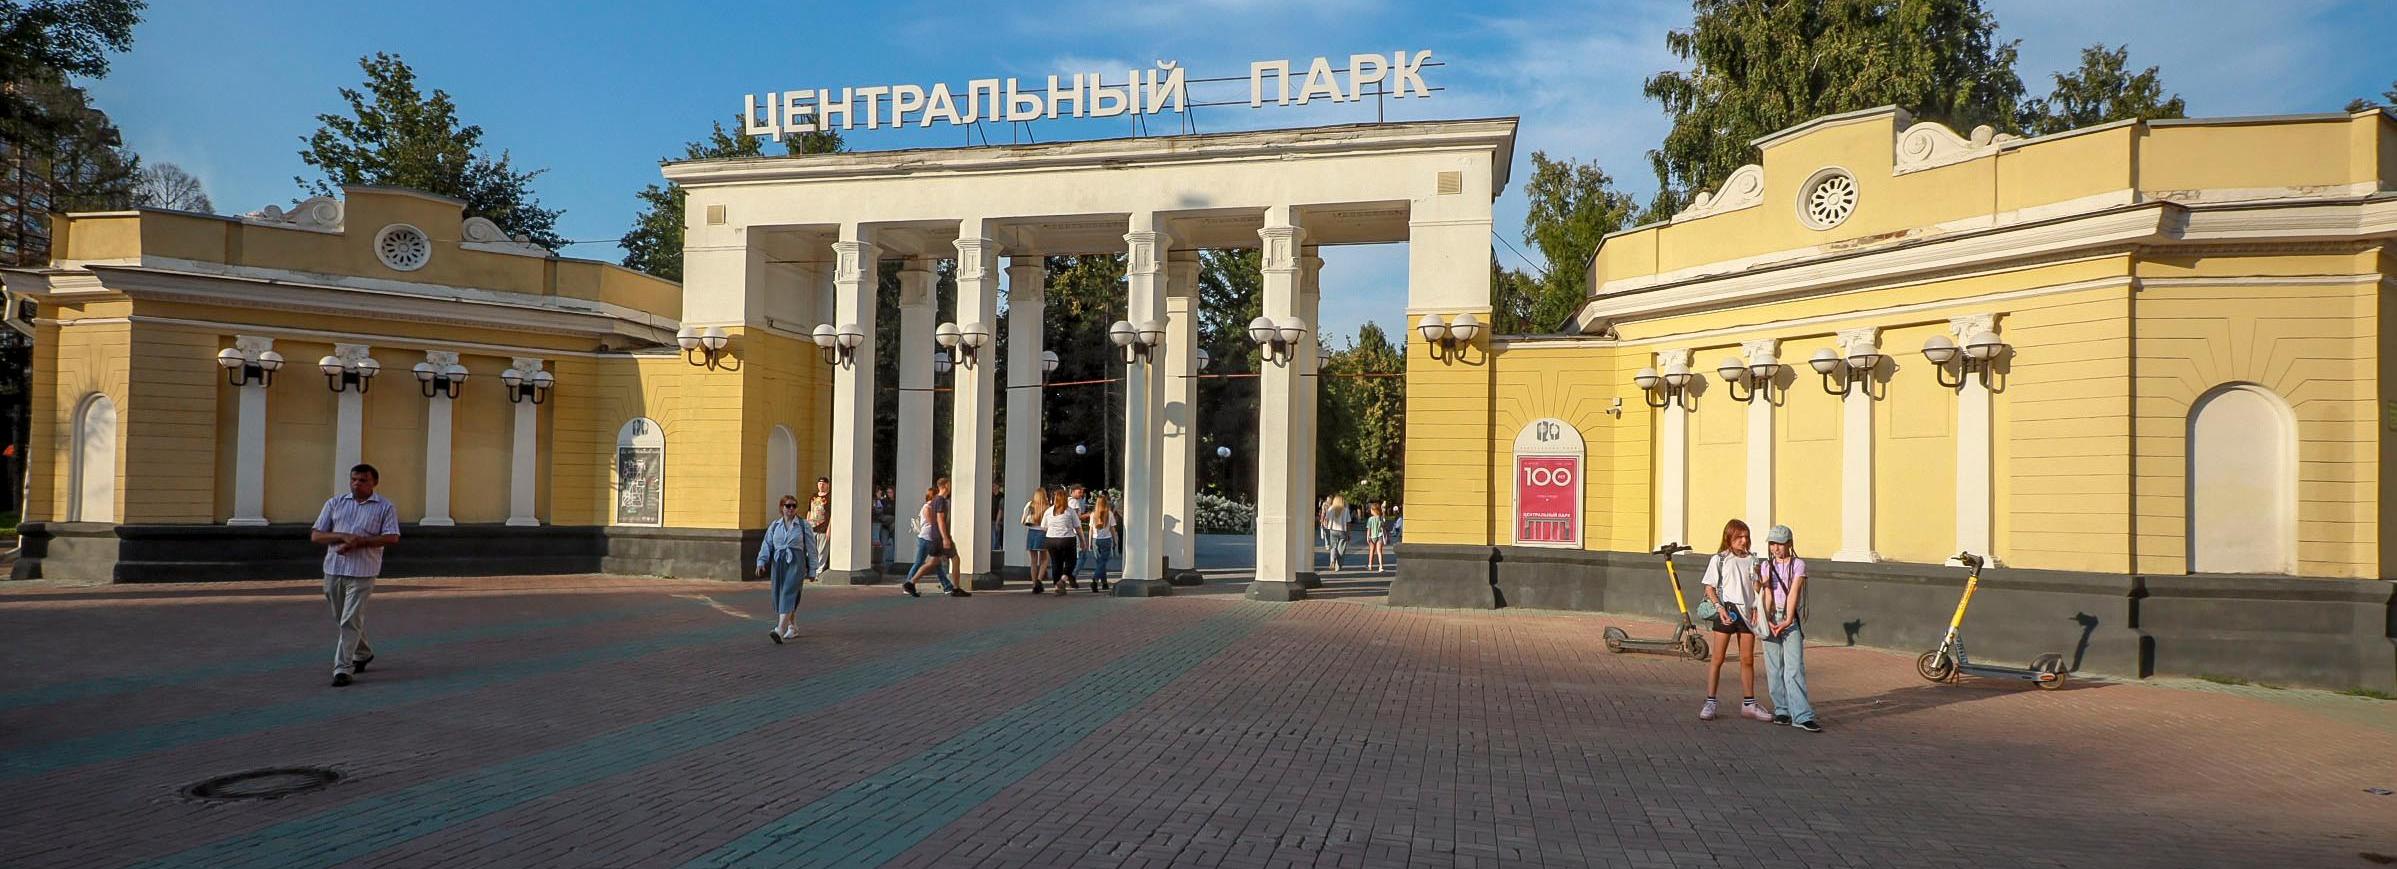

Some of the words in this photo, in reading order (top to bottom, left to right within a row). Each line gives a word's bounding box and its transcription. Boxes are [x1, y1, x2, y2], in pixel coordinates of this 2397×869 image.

[744, 60, 1185, 141] ЦЕНТРАЛЬНЫЙ
[1251, 50, 1432, 108] ПАРК
[1524, 467, 1572, 487] 100
